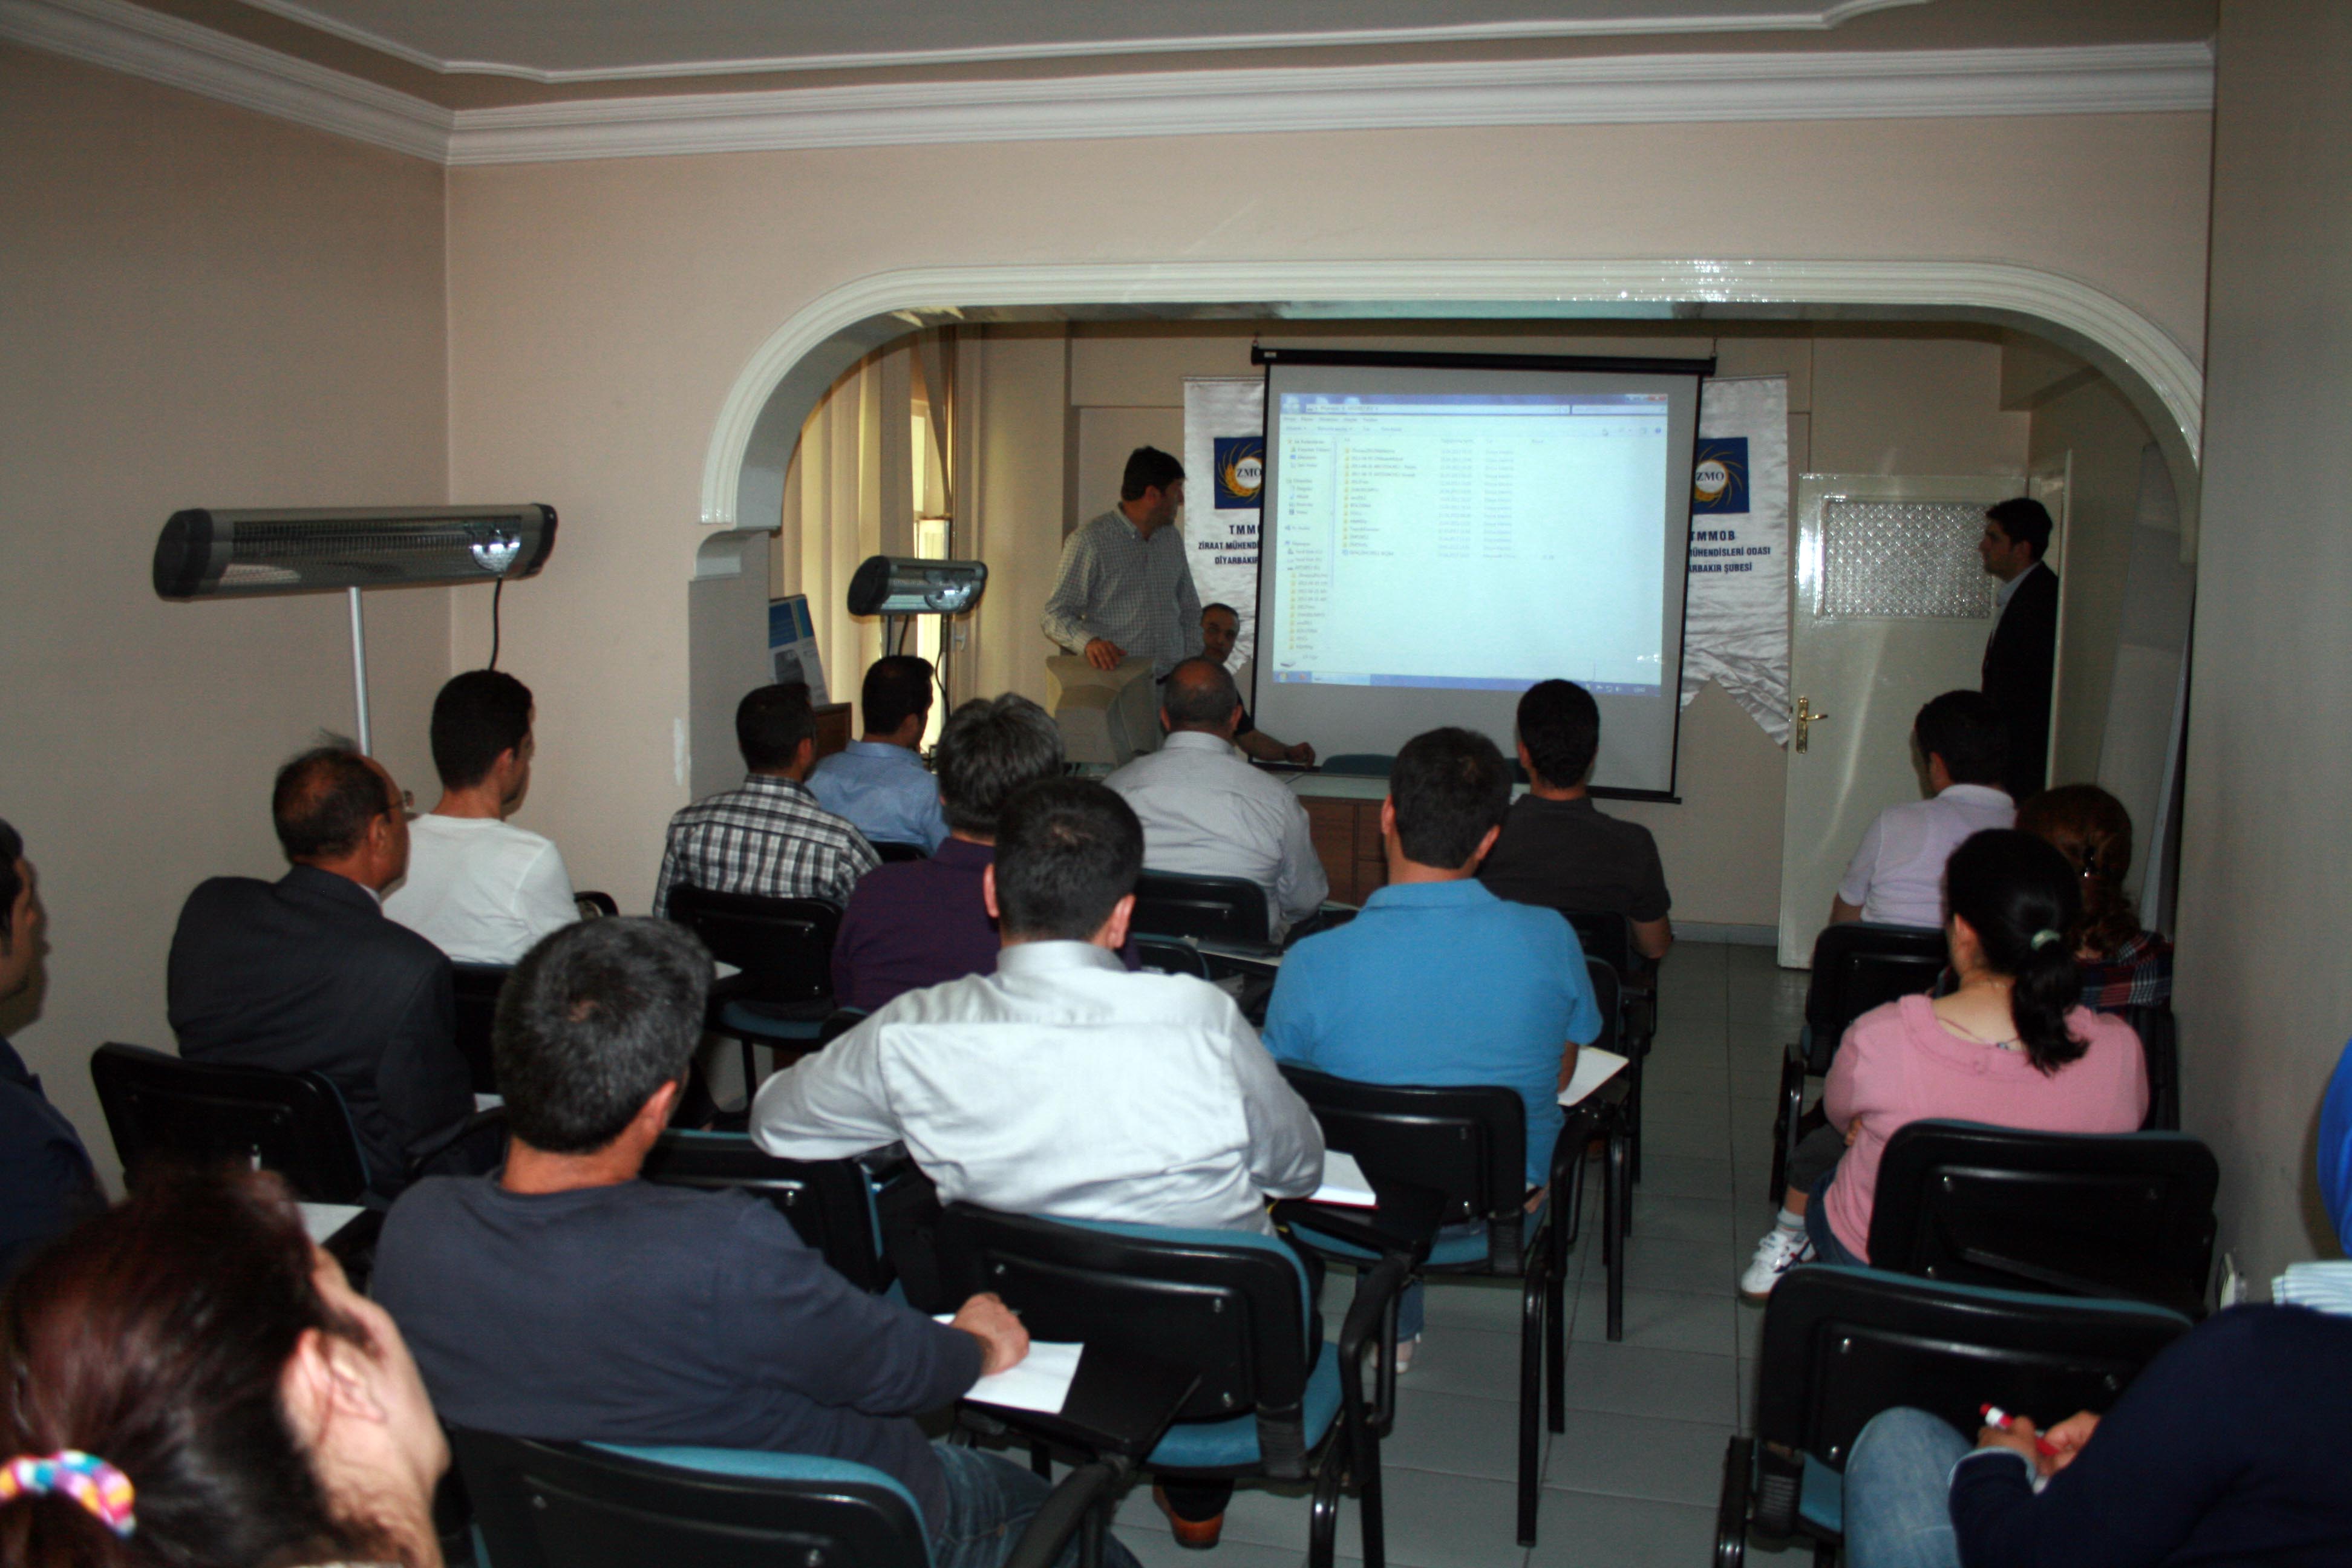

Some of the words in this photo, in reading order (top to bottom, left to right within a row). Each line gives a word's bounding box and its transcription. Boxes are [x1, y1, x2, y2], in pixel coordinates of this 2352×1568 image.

[1696, 471, 1725, 482] ZMO
[1198, 540, 1223, 550] ZİRAAT
[1746, 547, 1771, 555] ODASI
